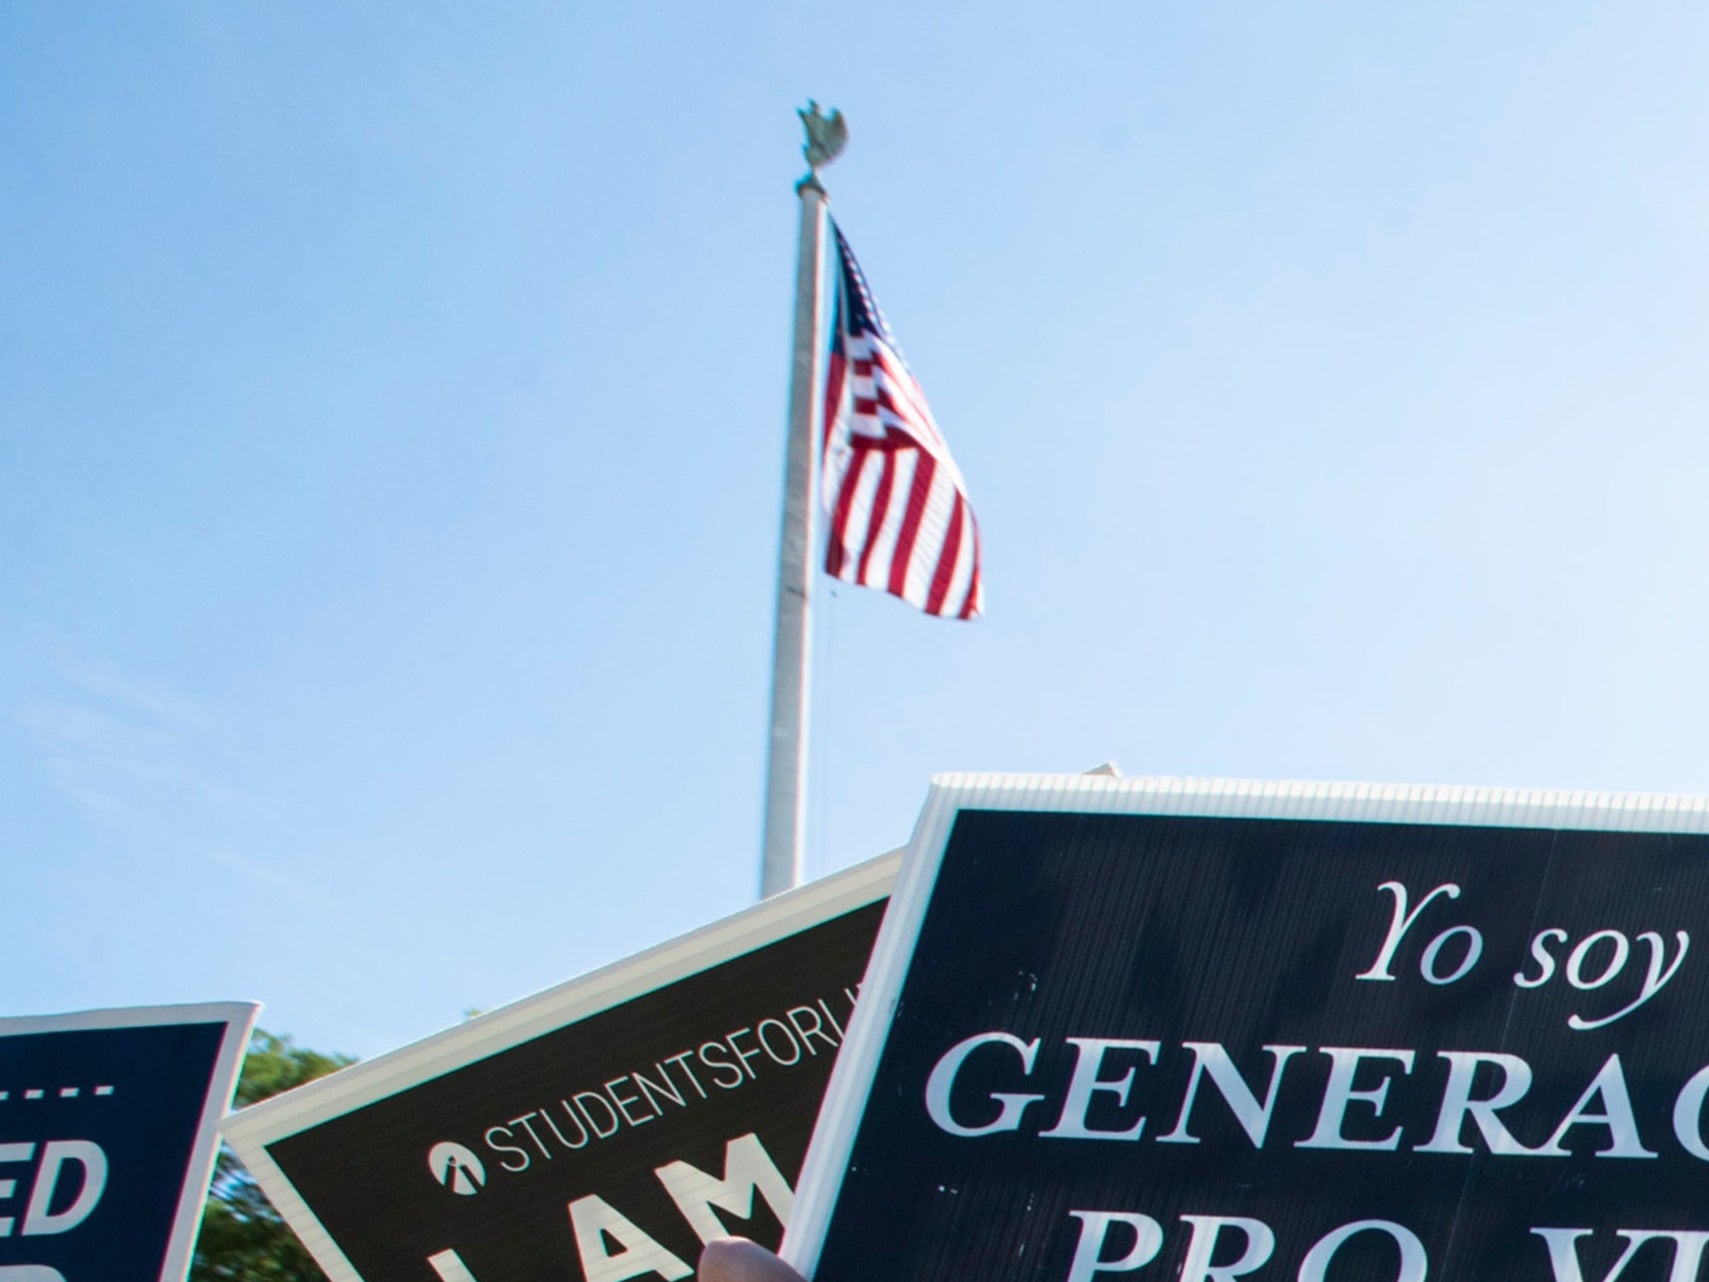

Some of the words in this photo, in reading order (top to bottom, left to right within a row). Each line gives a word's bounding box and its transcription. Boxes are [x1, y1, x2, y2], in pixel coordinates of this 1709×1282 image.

[1355, 879, 1482, 992] Yo
[1511, 926, 1693, 1032] soy
[485, 985, 860, 1173] STUDENTSFORL
